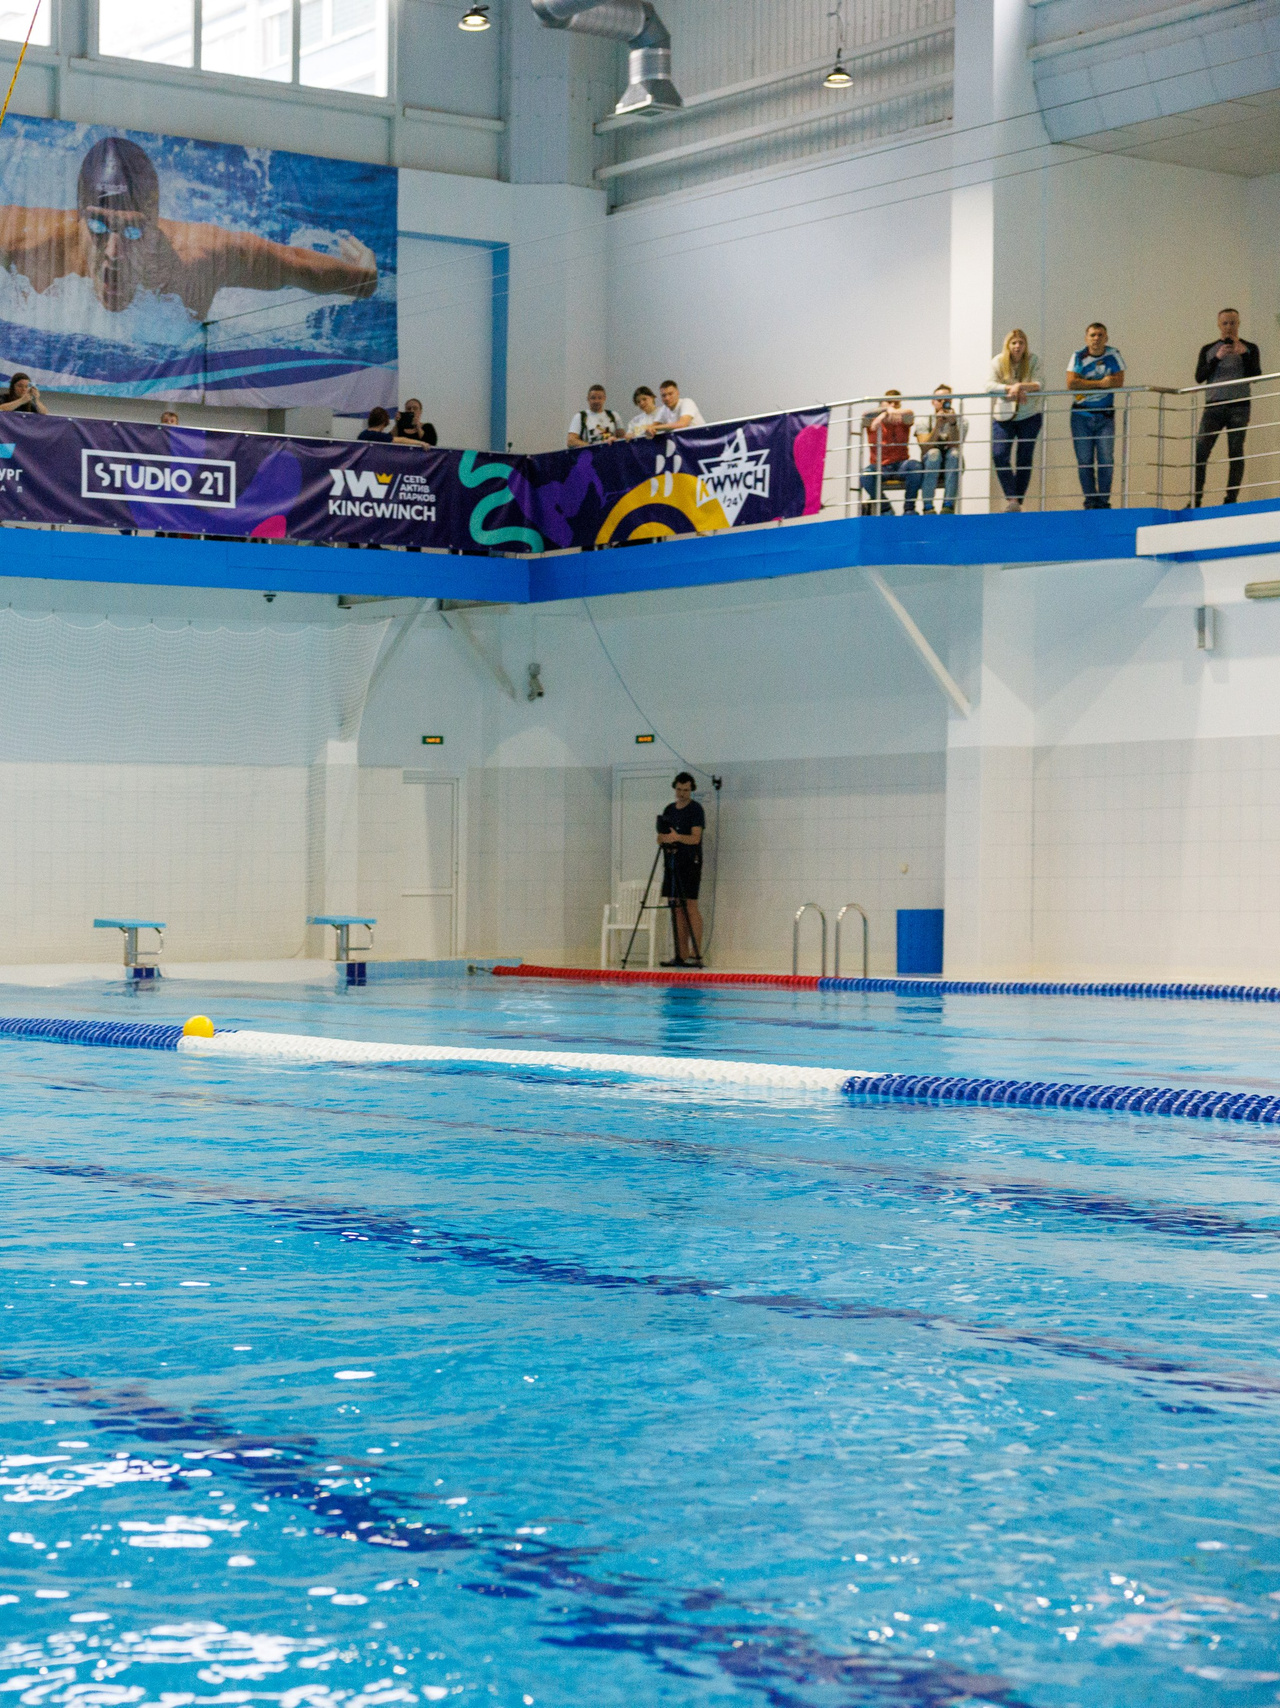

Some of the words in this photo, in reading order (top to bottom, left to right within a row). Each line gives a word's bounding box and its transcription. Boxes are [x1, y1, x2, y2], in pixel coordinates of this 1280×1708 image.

[94, 463, 192, 492] STUDIO
[199, 471, 224, 496] 21
[403, 475, 427, 484] СЕТЬ
[699, 468, 766, 501] KWWCH
[400, 484, 430, 493] АКТИВ
[399, 492, 436, 502] ПАРКОВ
[328, 499, 436, 522] KINGWINCH
